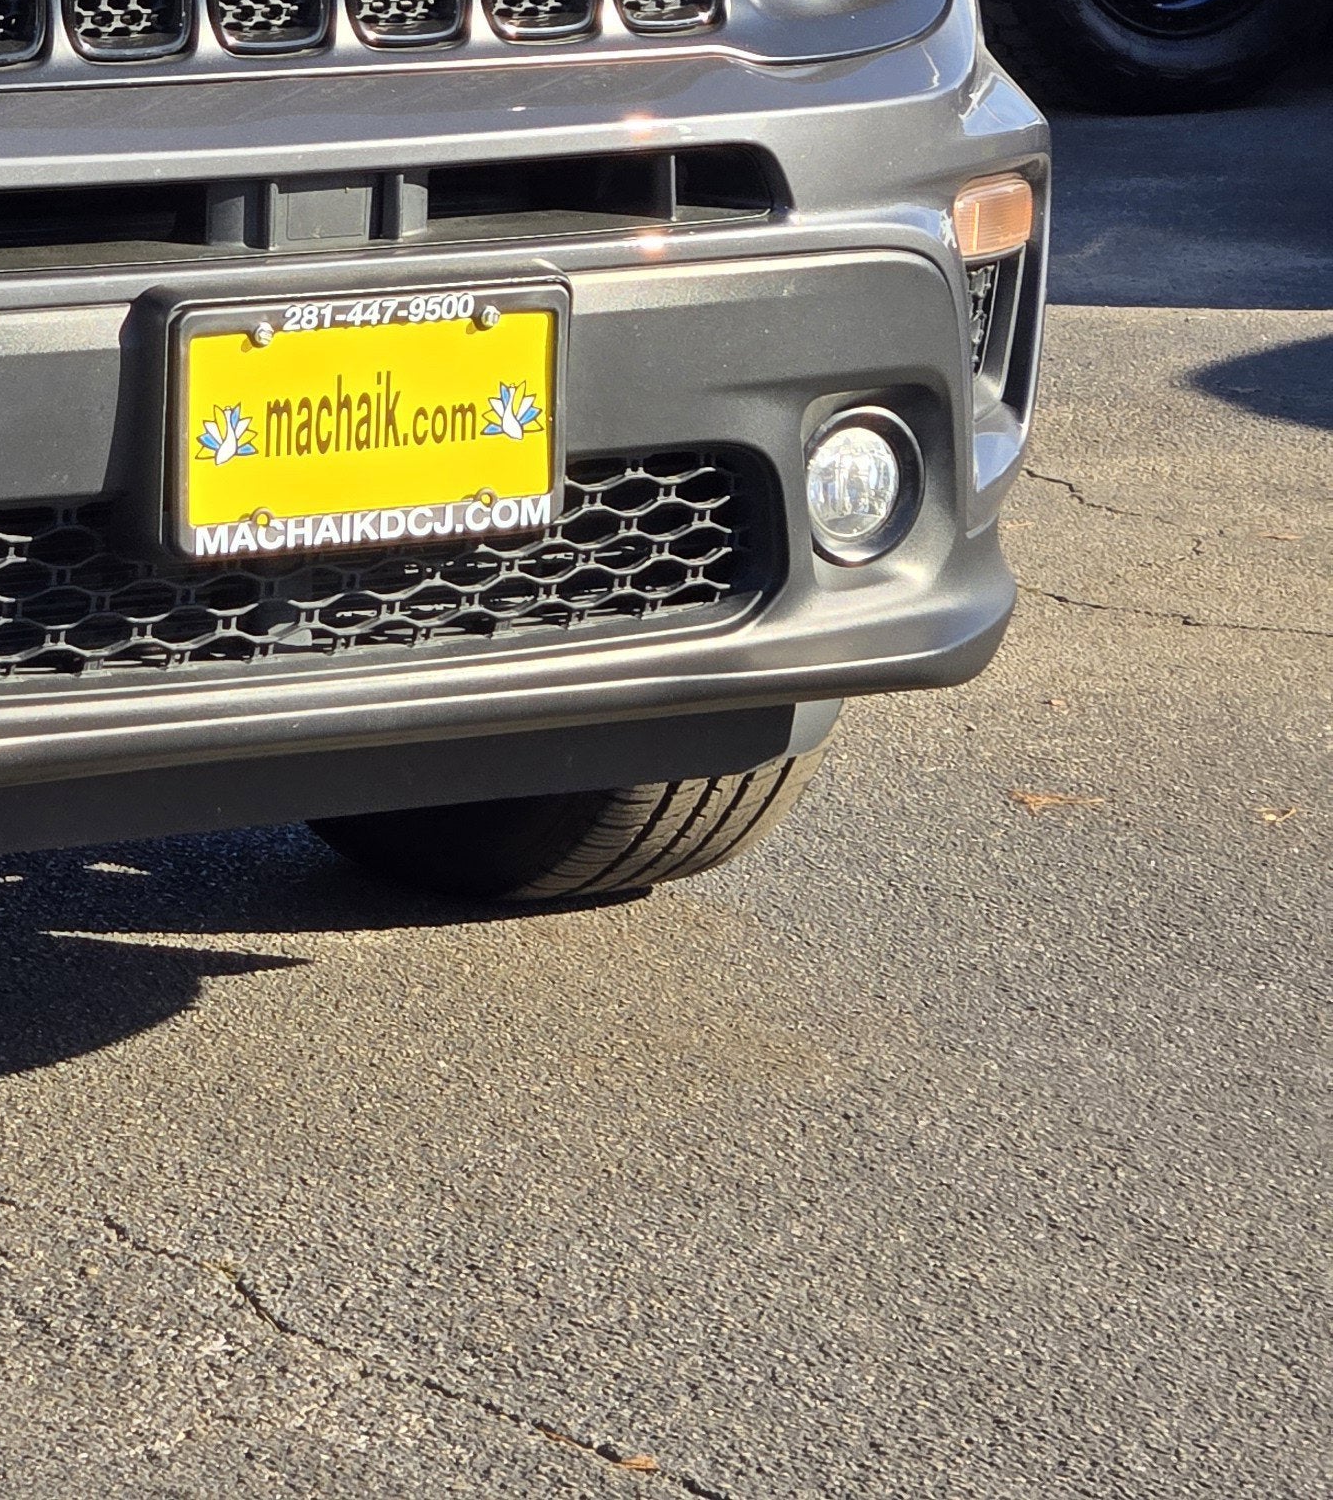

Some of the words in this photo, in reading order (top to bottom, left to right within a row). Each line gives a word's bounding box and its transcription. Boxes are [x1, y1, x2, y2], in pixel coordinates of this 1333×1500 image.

[283, 294, 475, 331] 281-447-9500
[264, 371, 478, 458] machaik.com
[195, 495, 552, 557] MACHAIKDCJ.COM
